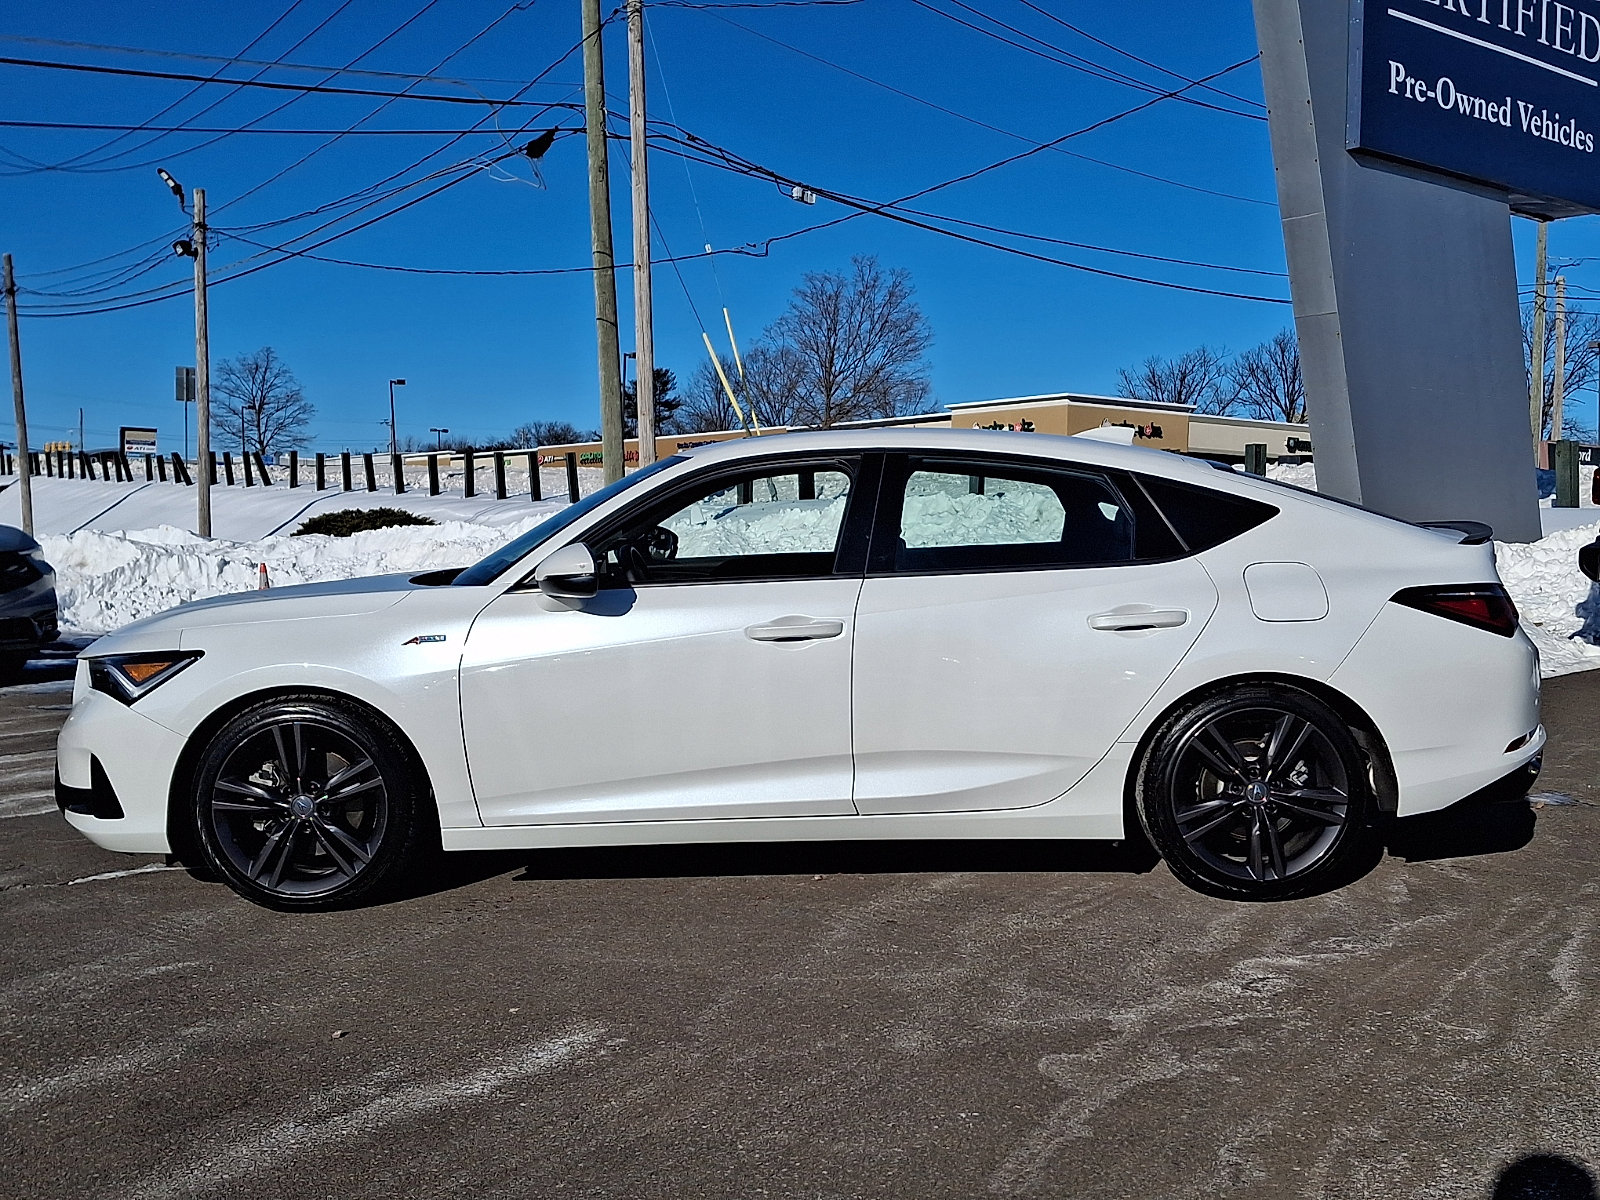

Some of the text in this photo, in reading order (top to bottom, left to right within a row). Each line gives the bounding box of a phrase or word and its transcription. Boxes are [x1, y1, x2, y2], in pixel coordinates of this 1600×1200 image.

[1422, 0, 1600, 63] IFIED
[1388, 60, 1594, 153] Pre-Owned Vehicles
